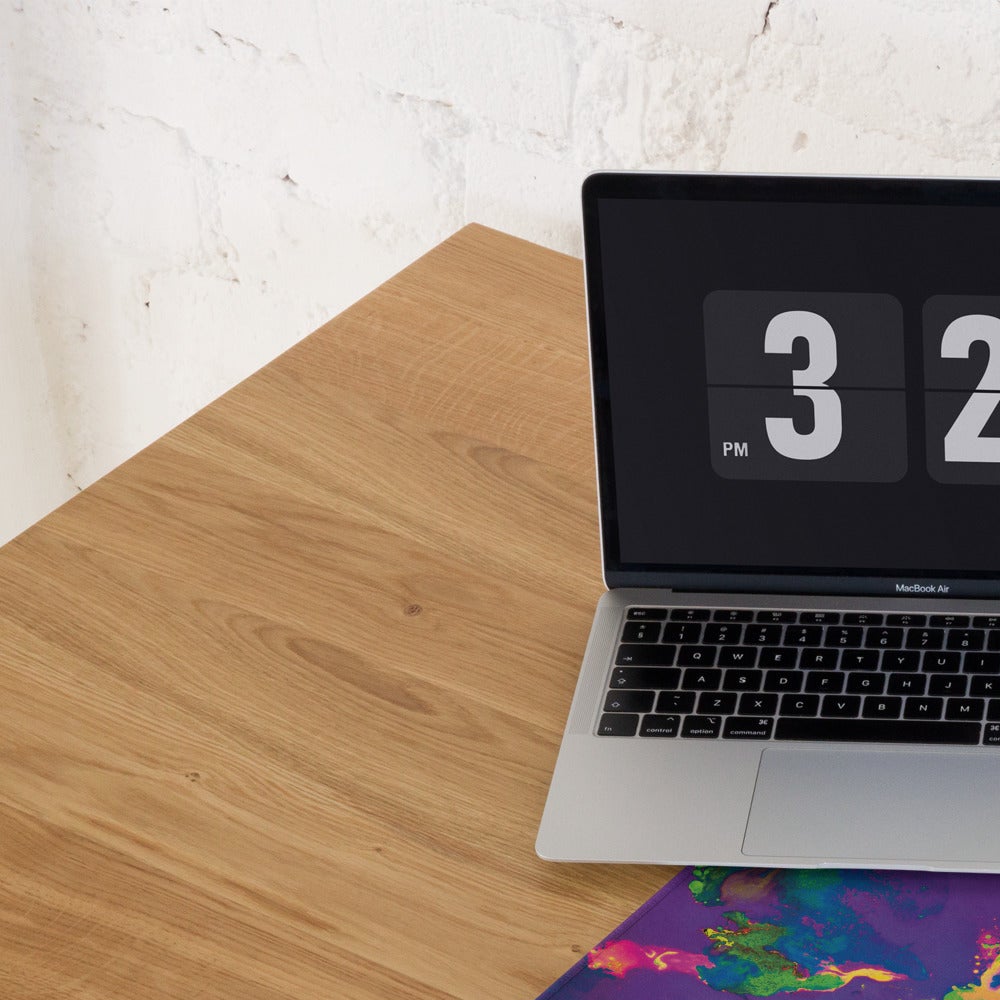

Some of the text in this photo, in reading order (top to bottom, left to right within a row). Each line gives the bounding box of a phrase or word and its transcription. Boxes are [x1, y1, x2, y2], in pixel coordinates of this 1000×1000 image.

[764, 310, 843, 460] 3
[722, 441, 749, 457] PM
[895, 584, 950, 593] MacBook Air
